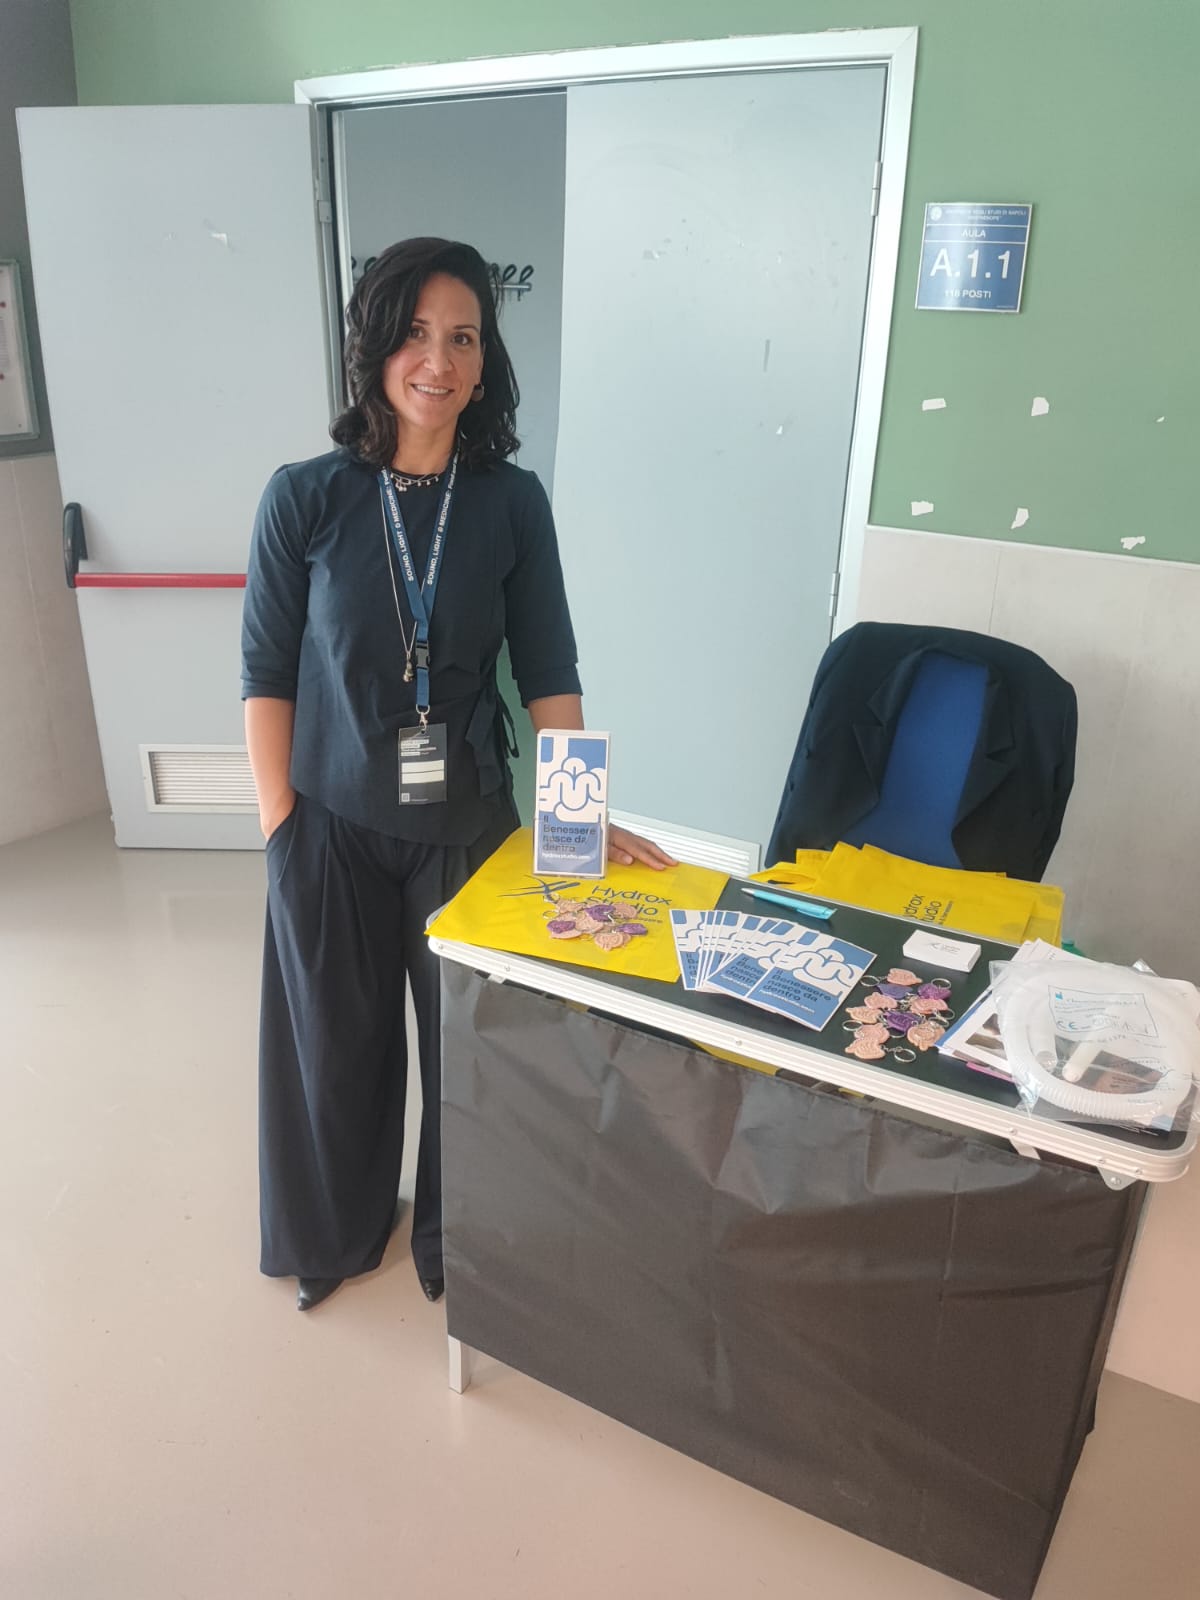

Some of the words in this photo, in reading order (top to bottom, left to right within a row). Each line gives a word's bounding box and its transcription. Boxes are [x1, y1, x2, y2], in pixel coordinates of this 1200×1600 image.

[962, 229, 986, 238] AULA
[929, 247, 1011, 279] A.1.1
[962, 289, 991, 299] POSTI
[396, 531, 407, 552] LIGHT
[427, 556, 439, 585] SOUND,
[433, 534, 443, 556] LIGHT
[543, 815, 549, 823] Il
[543, 823, 597, 836] Benessere
[542, 843, 576, 853] dentro
[592, 885, 672, 905] Hydrox
[903, 894, 926, 920] ydrox
[762, 984, 801, 1001] dentro
[767, 980, 801, 995] nasce
[803, 992, 818, 1002] da
[771, 974, 832, 1001] Benessere
